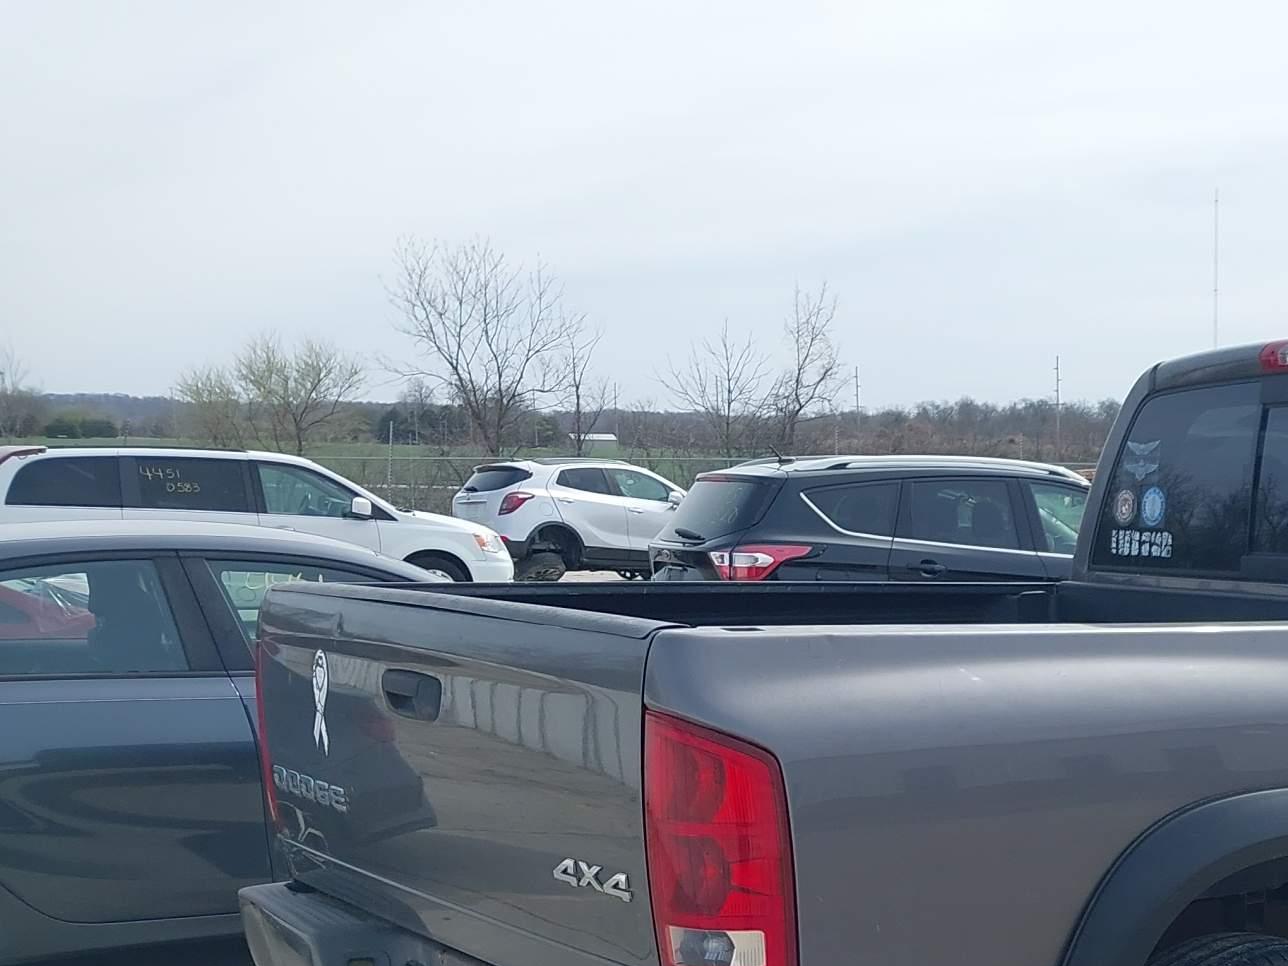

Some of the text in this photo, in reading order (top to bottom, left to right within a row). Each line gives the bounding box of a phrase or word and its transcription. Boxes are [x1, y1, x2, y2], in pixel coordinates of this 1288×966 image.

[139, 465, 180, 480] 4451
[166, 482, 201, 493] 0583
[273, 764, 348, 813] DODGE
